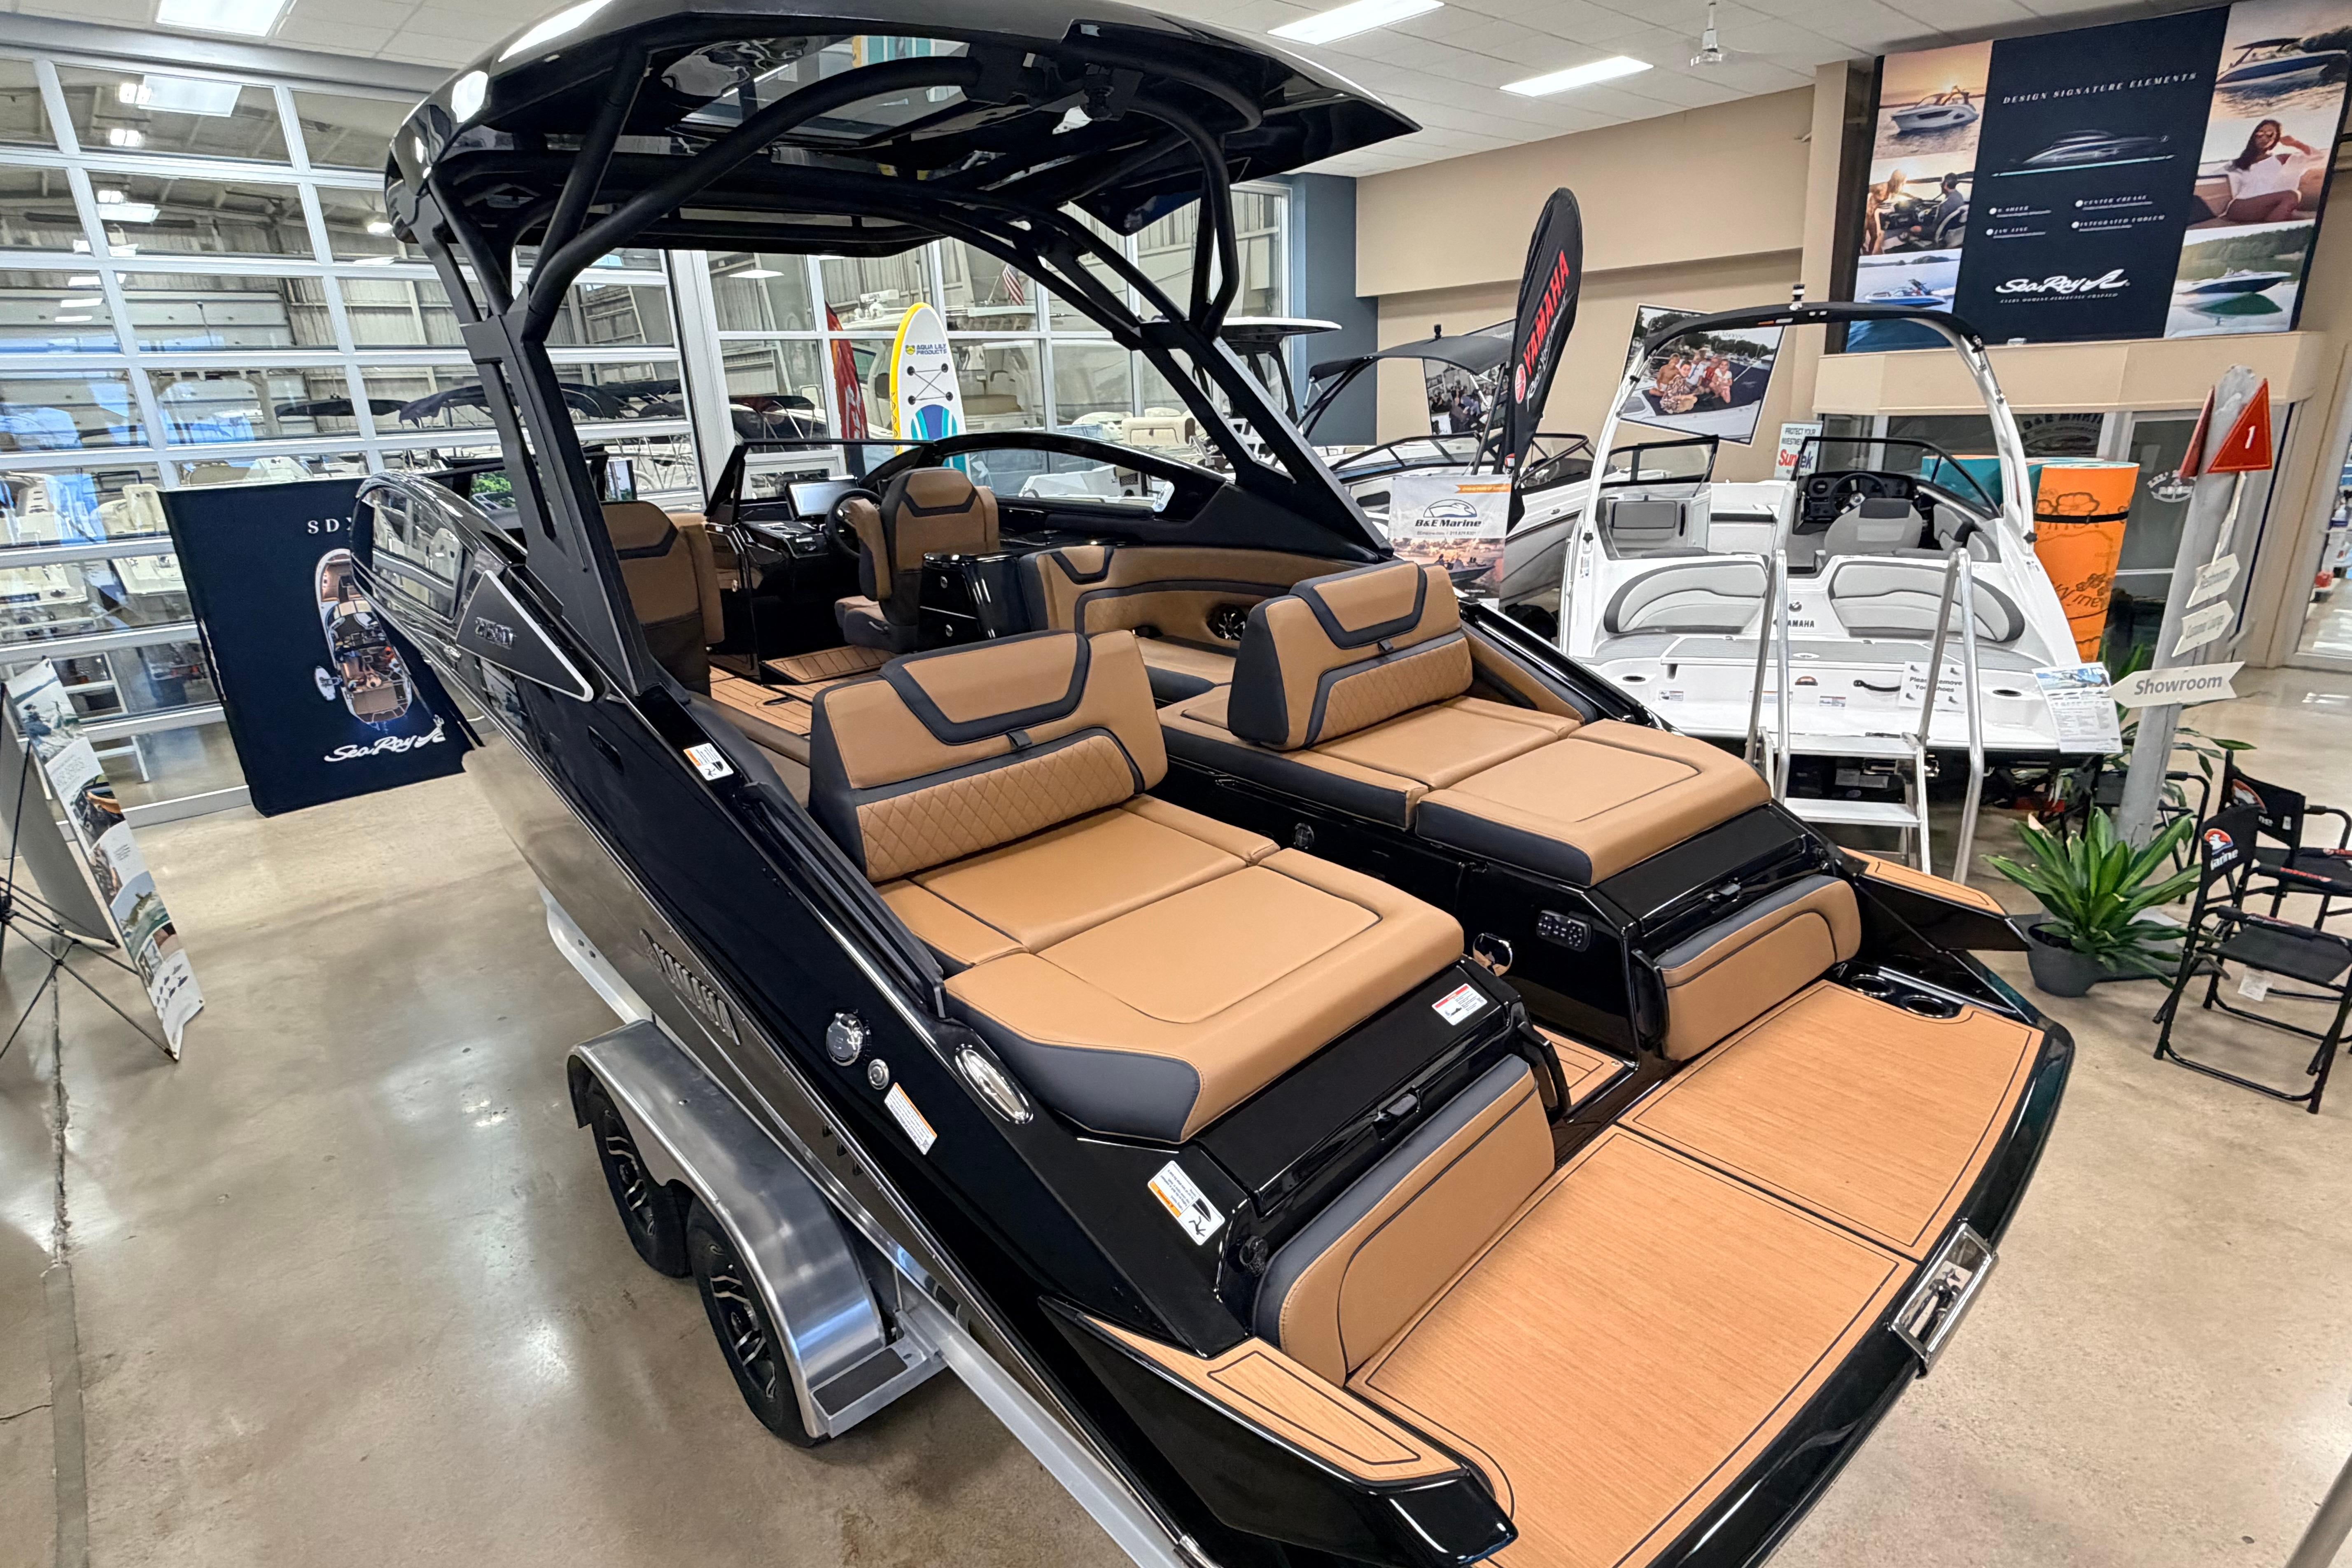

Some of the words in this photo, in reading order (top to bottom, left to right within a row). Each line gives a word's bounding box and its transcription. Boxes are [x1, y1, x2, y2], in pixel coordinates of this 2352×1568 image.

[2002, 92, 2047, 105] DESIGN
[2053, 82, 2124, 99] SIGNATURE
[2129, 72, 2197, 89] ELEMENTS
[1524, 250, 1570, 376] YAMAHA
[2245, 425, 2256, 449] 1
[1778, 449, 1813, 469] Sunek
[1415, 519, 1437, 527] B&E
[1439, 519, 1482, 527] Marine
[1787, 619, 1815, 628] AMAHA
[2133, 676, 2223, 696] Showroom
[324, 744, 373, 762] Sea
[372, 736, 417, 756] Ray
